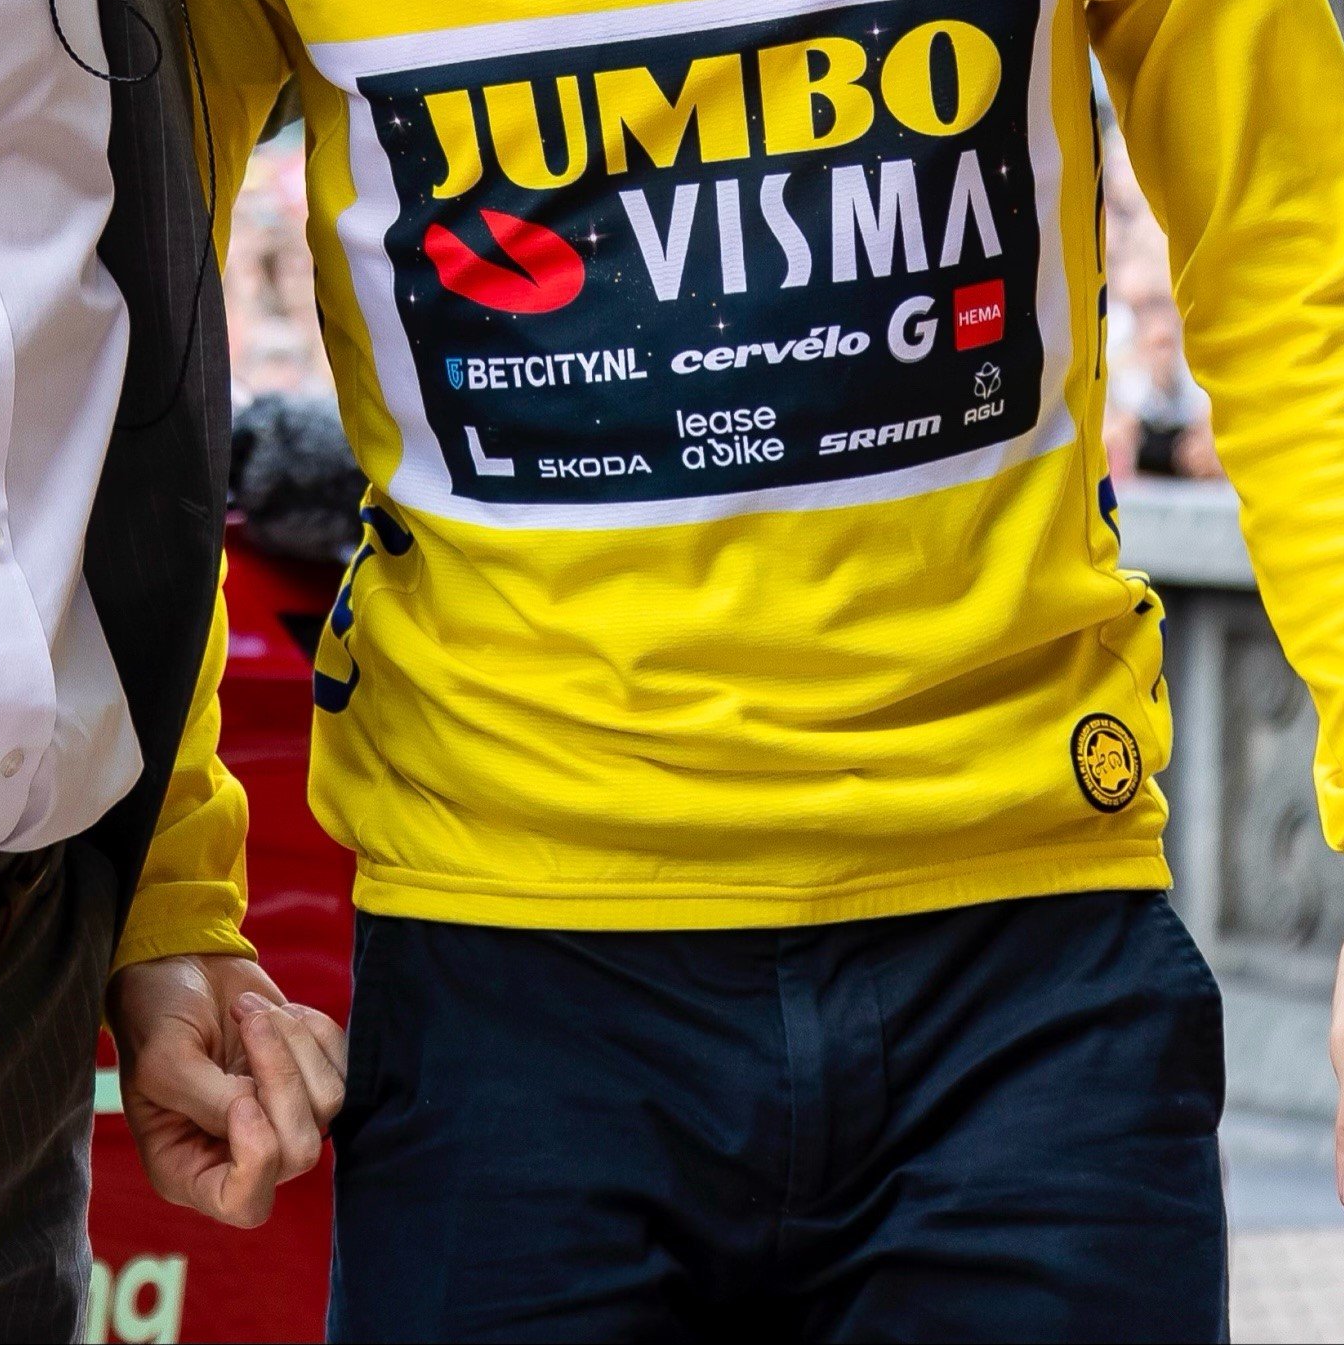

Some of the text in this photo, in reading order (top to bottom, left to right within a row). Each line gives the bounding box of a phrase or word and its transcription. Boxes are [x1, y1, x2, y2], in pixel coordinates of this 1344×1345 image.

[423, 19, 1002, 200] JUMBO
[618, 149, 1003, 302] VISMA
[958, 304, 1001, 327] HEMA
[467, 295, 939, 390] BETCITY.NL cervélo G
[676, 406, 776, 438] lease
[964, 399, 1004, 425] AGU
[819, 415, 942, 455] SRAM
